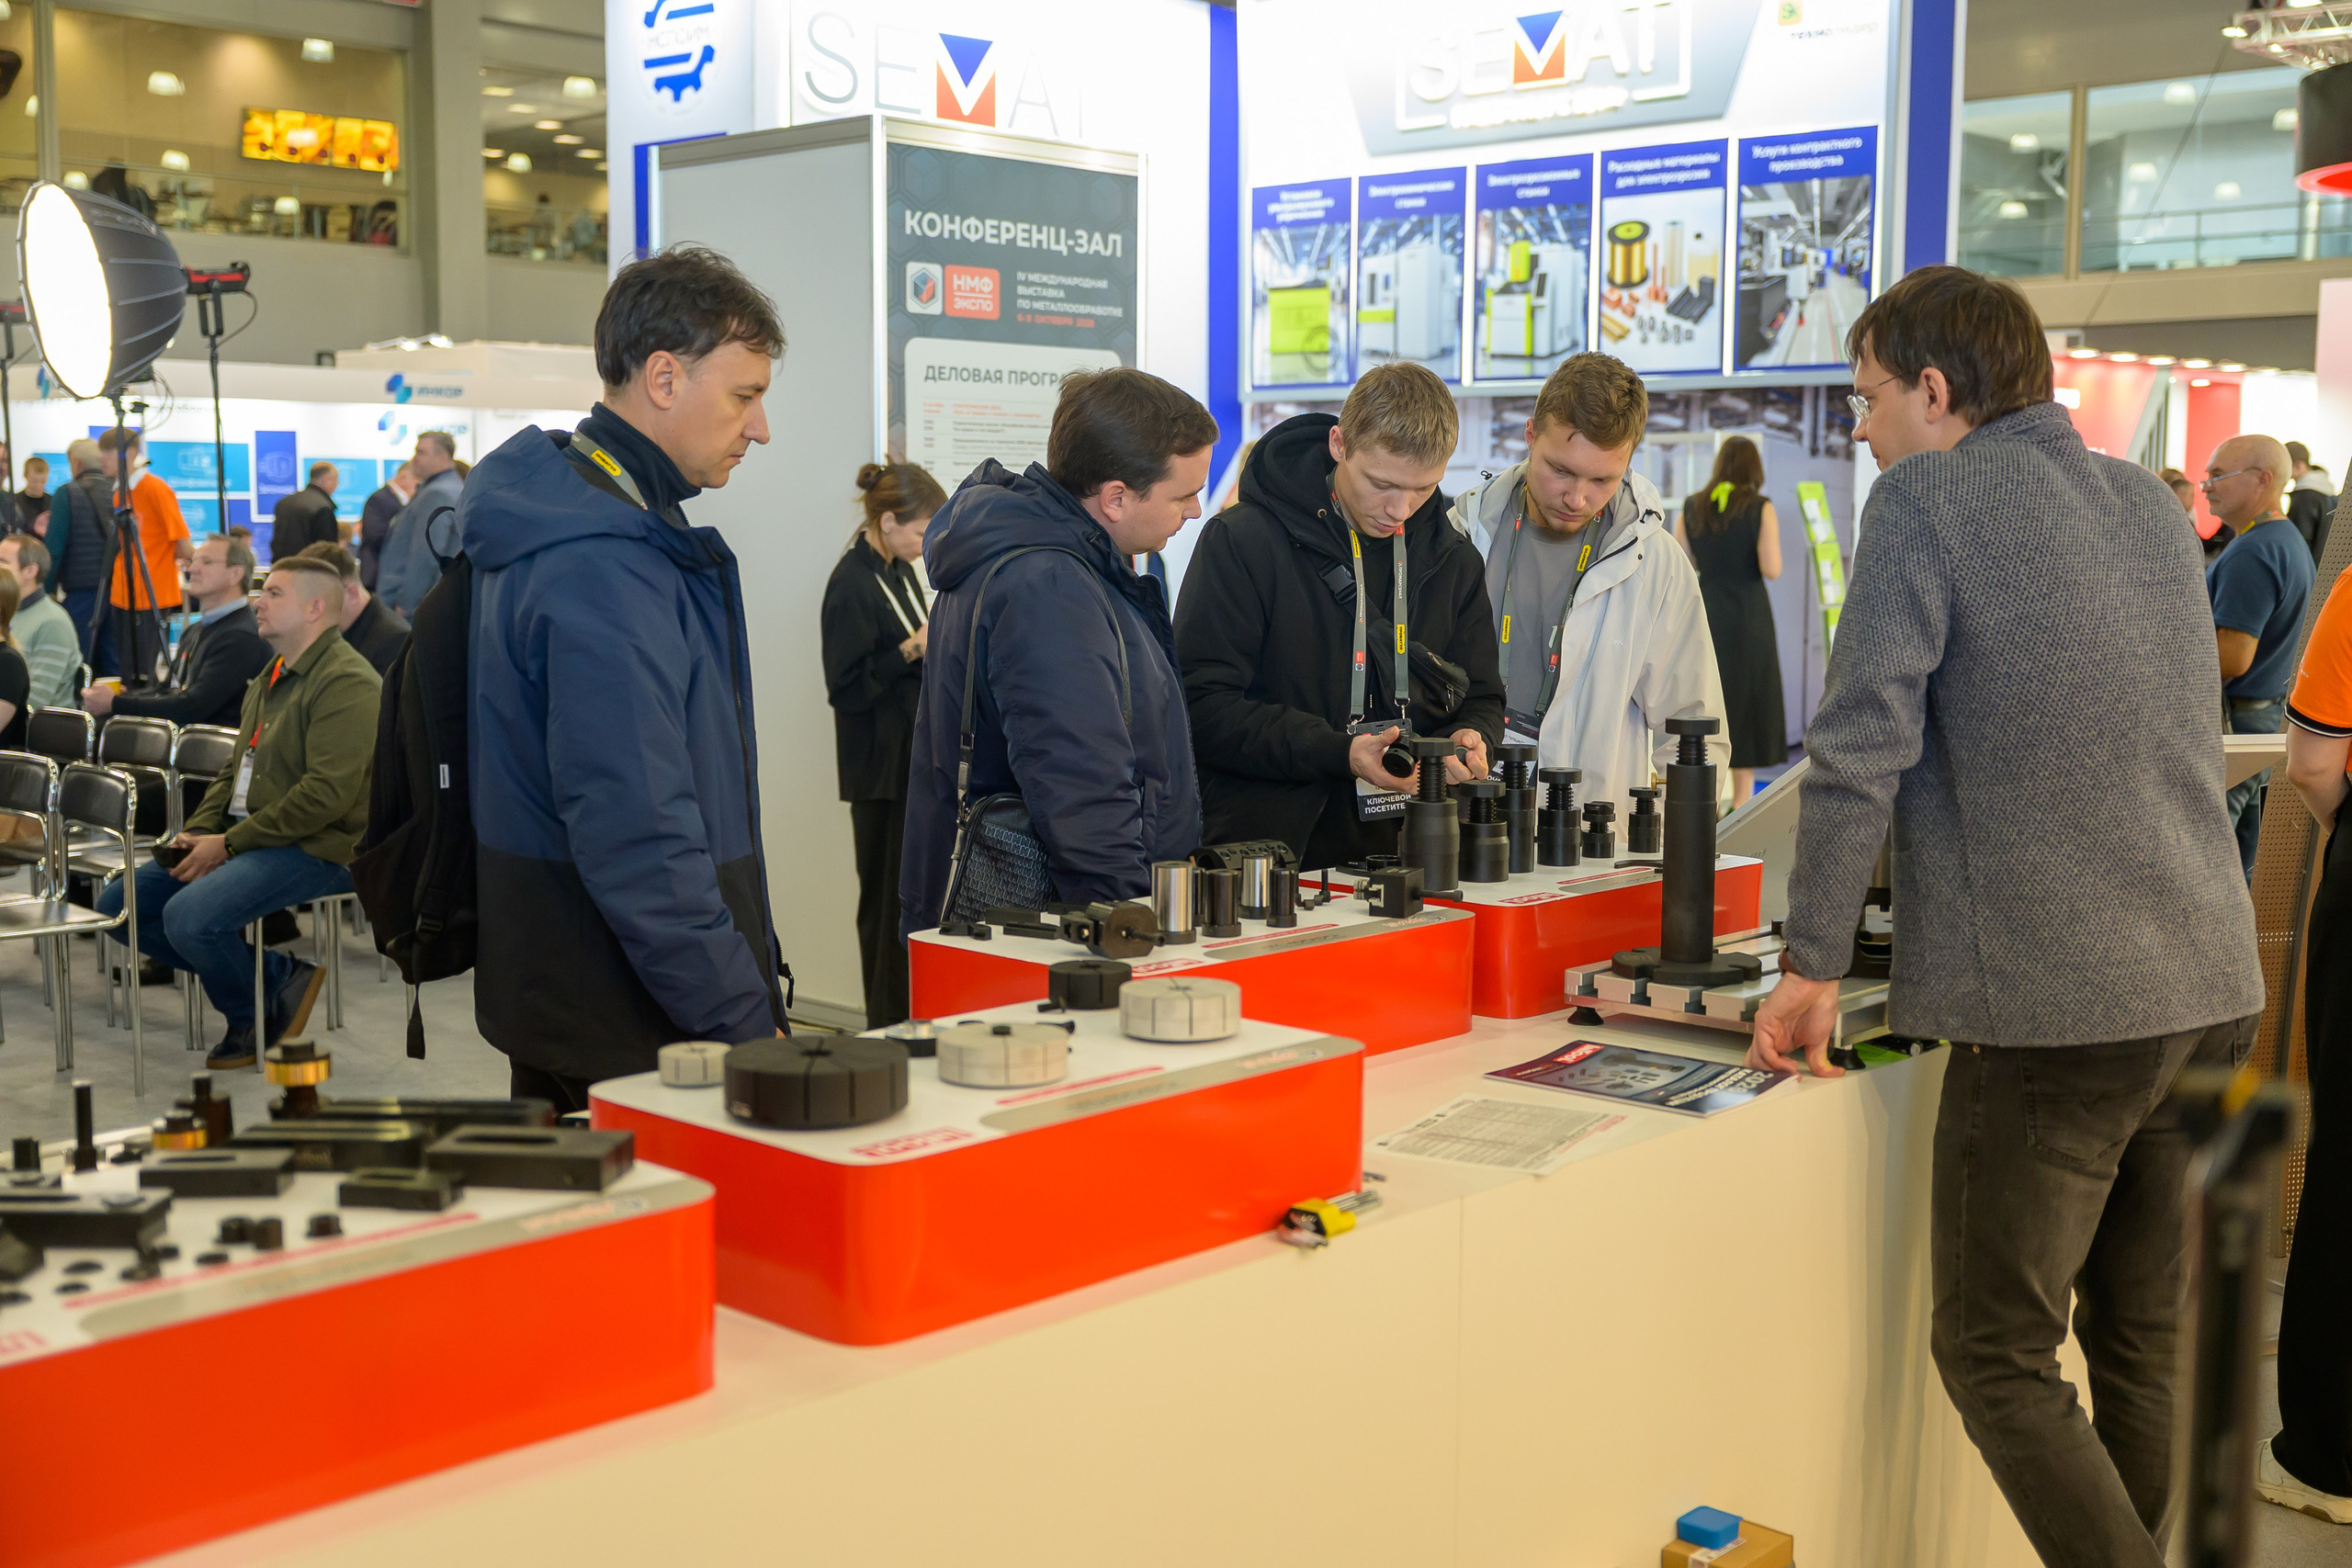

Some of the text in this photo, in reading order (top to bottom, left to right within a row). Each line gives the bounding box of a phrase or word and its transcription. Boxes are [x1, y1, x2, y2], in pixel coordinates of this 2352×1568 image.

[905, 209, 1123, 258] КОНФЕРЕНЦ-ЗАЛ
[952, 273, 994, 294] НМФ
[1027, 273, 1109, 289] МЕЖДУНАРОДНАЯ
[1016, 286, 1066, 299] ВЫСТАВКА
[952, 298, 994, 312] ЭКСПО
[1016, 299, 1124, 318] ПО МЕТАЛЛООБРАБОТКЕ
[923, 365, 1062, 388] ДЕЛОВАЯ ПРОГР
[1364, 802, 1407, 815] ПОСЕТИТЕ
